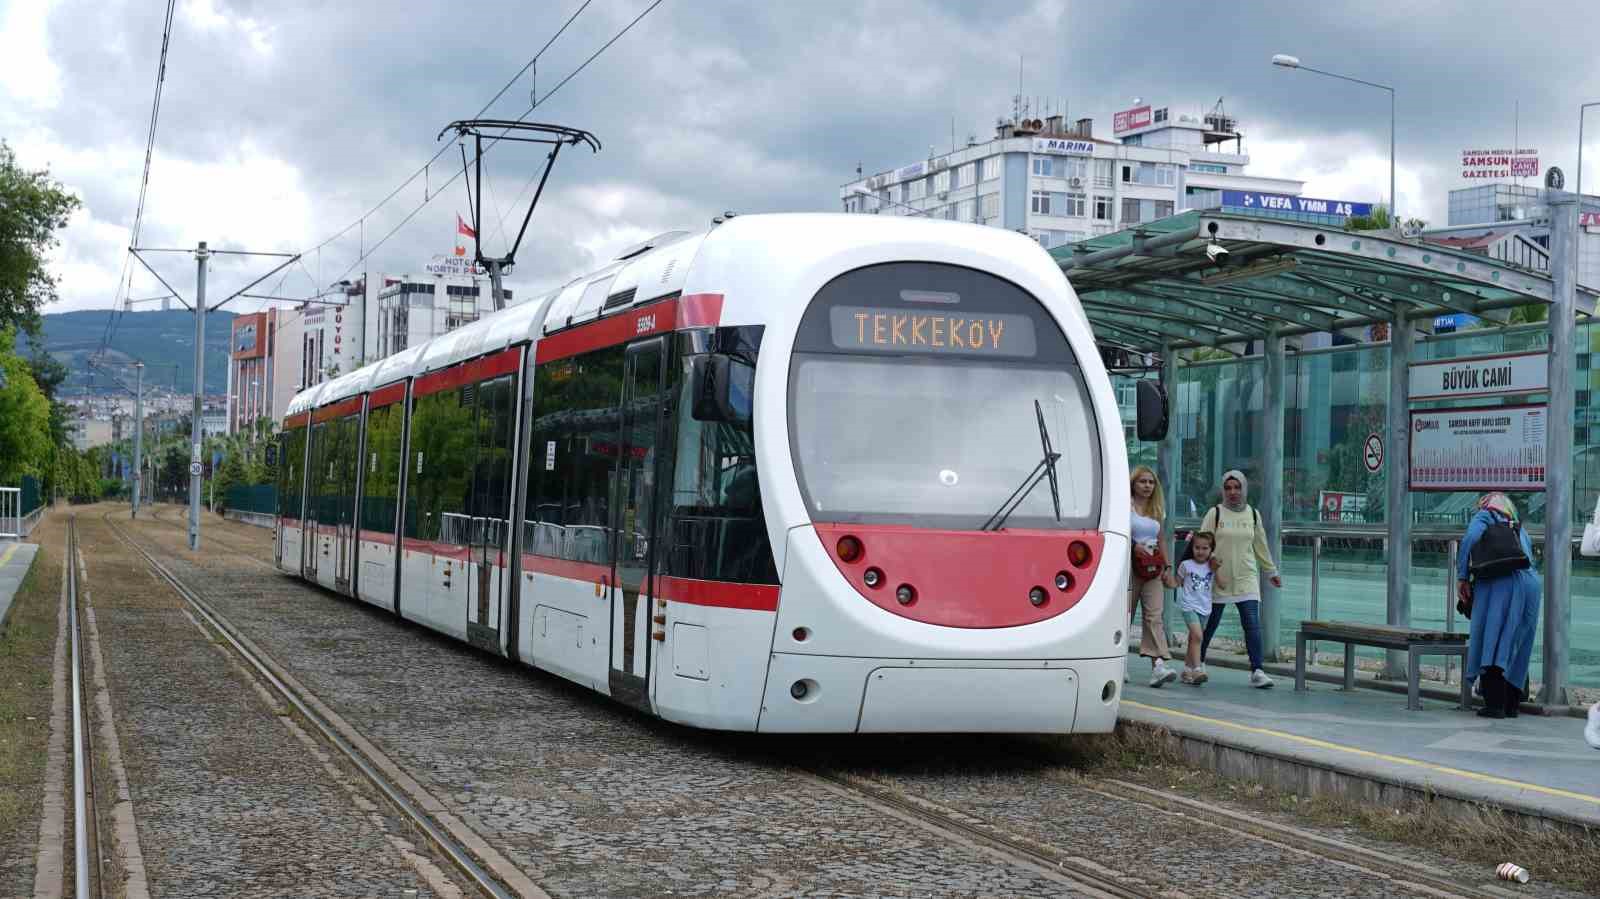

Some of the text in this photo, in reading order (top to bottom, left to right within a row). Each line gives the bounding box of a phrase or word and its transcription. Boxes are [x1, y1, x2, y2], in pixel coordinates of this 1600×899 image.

[1463, 157, 1508, 166] SAMSUN
[1260, 196, 1292, 209] VEFA
[1299, 199, 1327, 212] YMM
[854, 313, 1004, 349] TEKKEKÖY
[1442, 361, 1512, 390] BÜYÜK CAMİ
